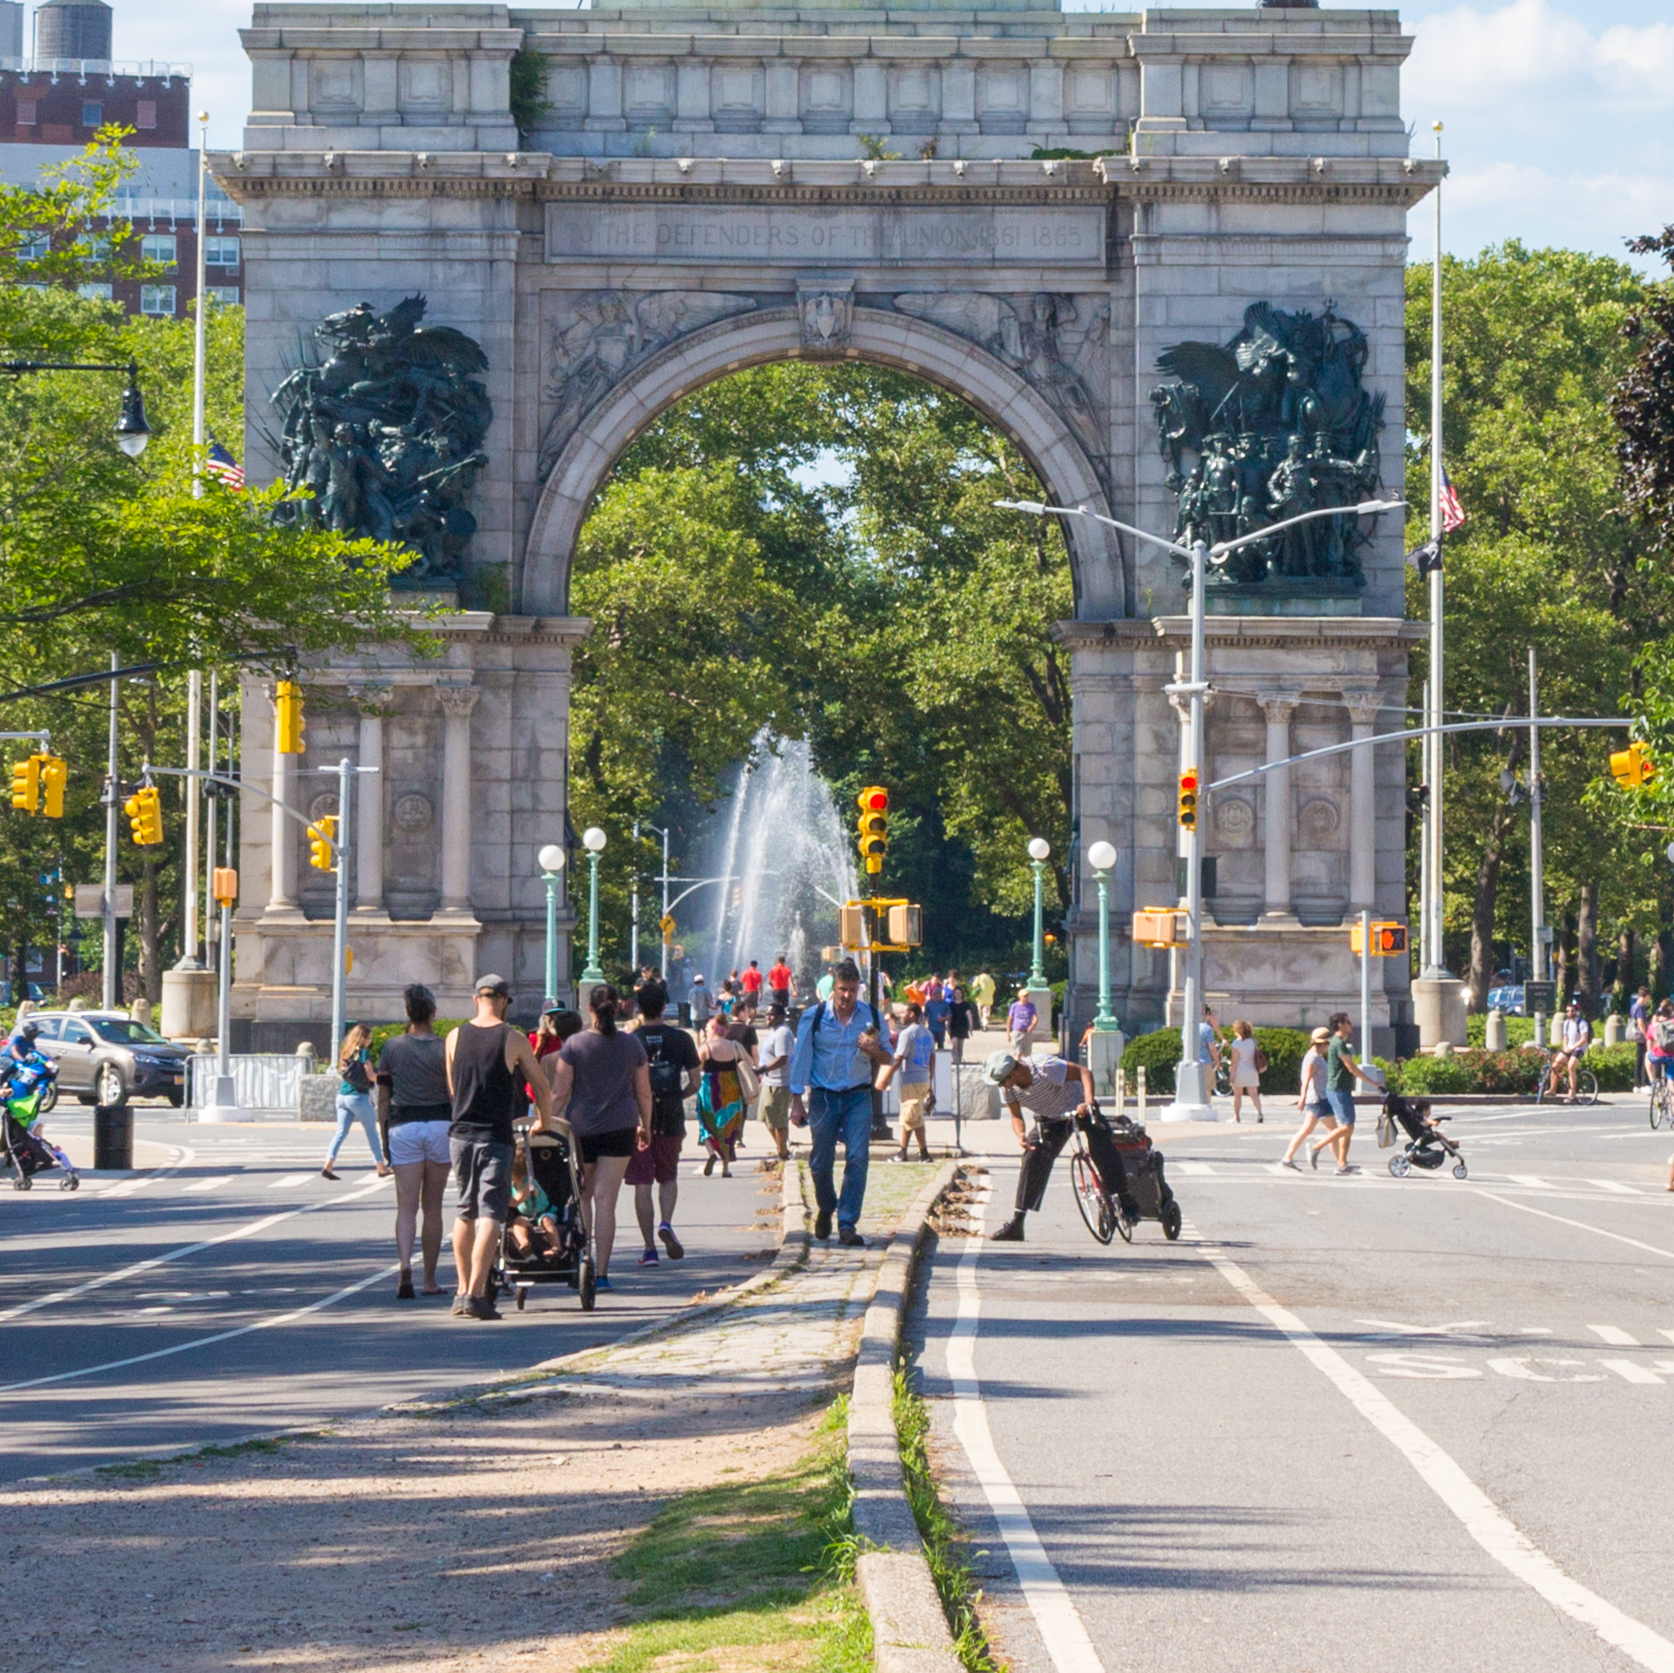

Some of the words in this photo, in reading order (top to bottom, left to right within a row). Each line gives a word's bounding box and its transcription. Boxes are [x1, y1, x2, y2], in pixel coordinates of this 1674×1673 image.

[566, 222, 594, 244] TO
[604, 222, 646, 245] THE
[656, 223, 799, 246] DEFENDERS
[812, 225, 842, 247] OF
[849, 225, 894, 247] THE
[903, 225, 971, 248] UNION
[979, 225, 1021, 247] 1861
[1031, 225, 1083, 247] 1865
